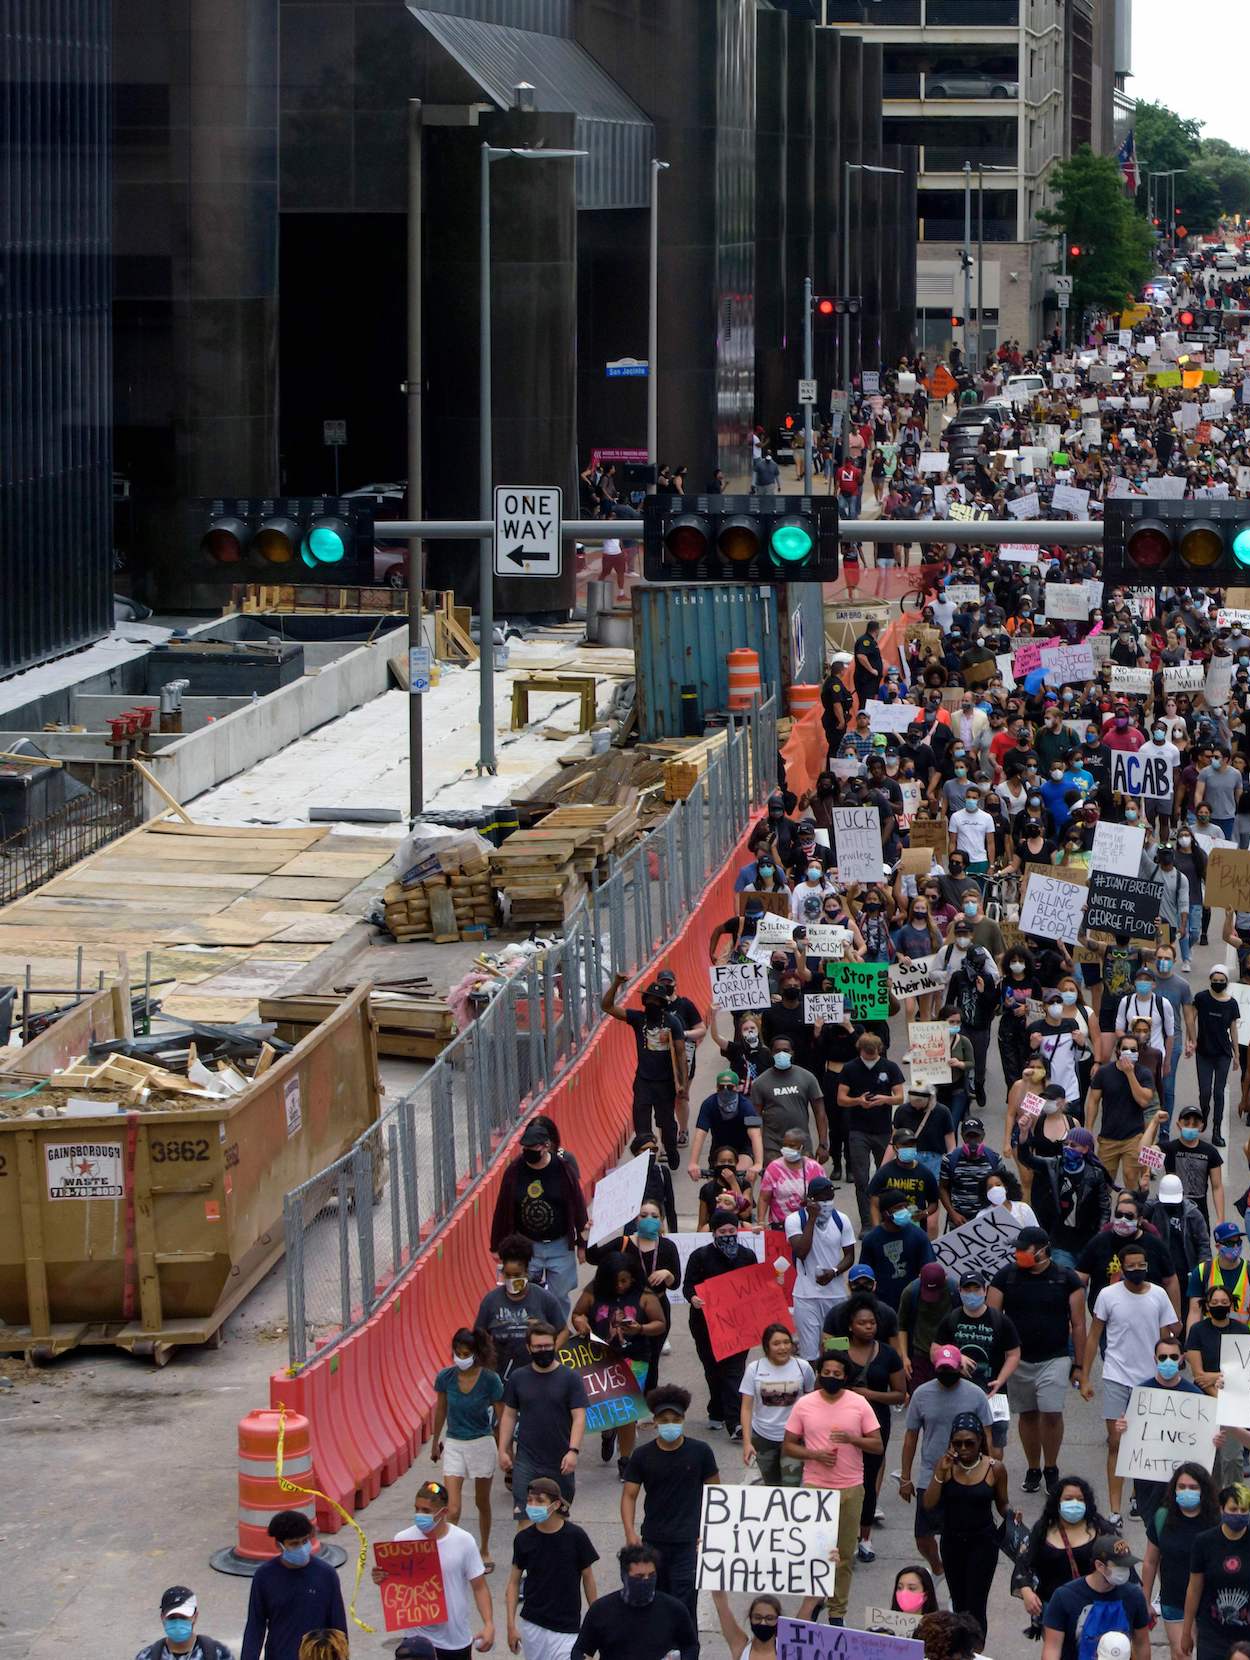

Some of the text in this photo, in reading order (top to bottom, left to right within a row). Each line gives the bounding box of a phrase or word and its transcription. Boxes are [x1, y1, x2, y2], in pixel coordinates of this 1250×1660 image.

[505, 495, 551, 515] ONE
[504, 520, 552, 540] WAY
[1048, 653, 1091, 665] JUSTICE
[1113, 754, 1169, 796] ACAB
[834, 810, 877, 829] FUCK
[1043, 878, 1080, 897] STOP
[1030, 889, 1075, 910] KILLING
[1091, 893, 1136, 913] JUSTICE FOR
[1037, 904, 1076, 925] BLACK
[1088, 909, 1155, 934] GEORGE FLOYD
[1031, 915, 1079, 941] PEOPLE
[807, 943, 842, 953] RACISM
[841, 967, 873, 989] Stop
[899, 962, 928, 975] Say
[713, 980, 760, 995] CORRUPT
[719, 993, 767, 1008] AMERICA
[807, 995, 842, 1003] WE WILL
[810, 1004, 823, 1012] NOT
[152, 1140, 209, 1162] 3862
[64, 1177, 109, 1187] WASTE
[932, 1212, 1021, 1266] BLACK
[582, 1364, 626, 1397] IVES
[584, 1396, 639, 1430] ATTER
[1137, 1392, 1209, 1422] BLACK
[1142, 1423, 1197, 1445] LIVES
[1129, 1448, 1193, 1473] MATTE
[705, 1487, 833, 1524] BLACK
[384, 1575, 442, 1610] GEORGE
[397, 1603, 440, 1626] FLOYD
